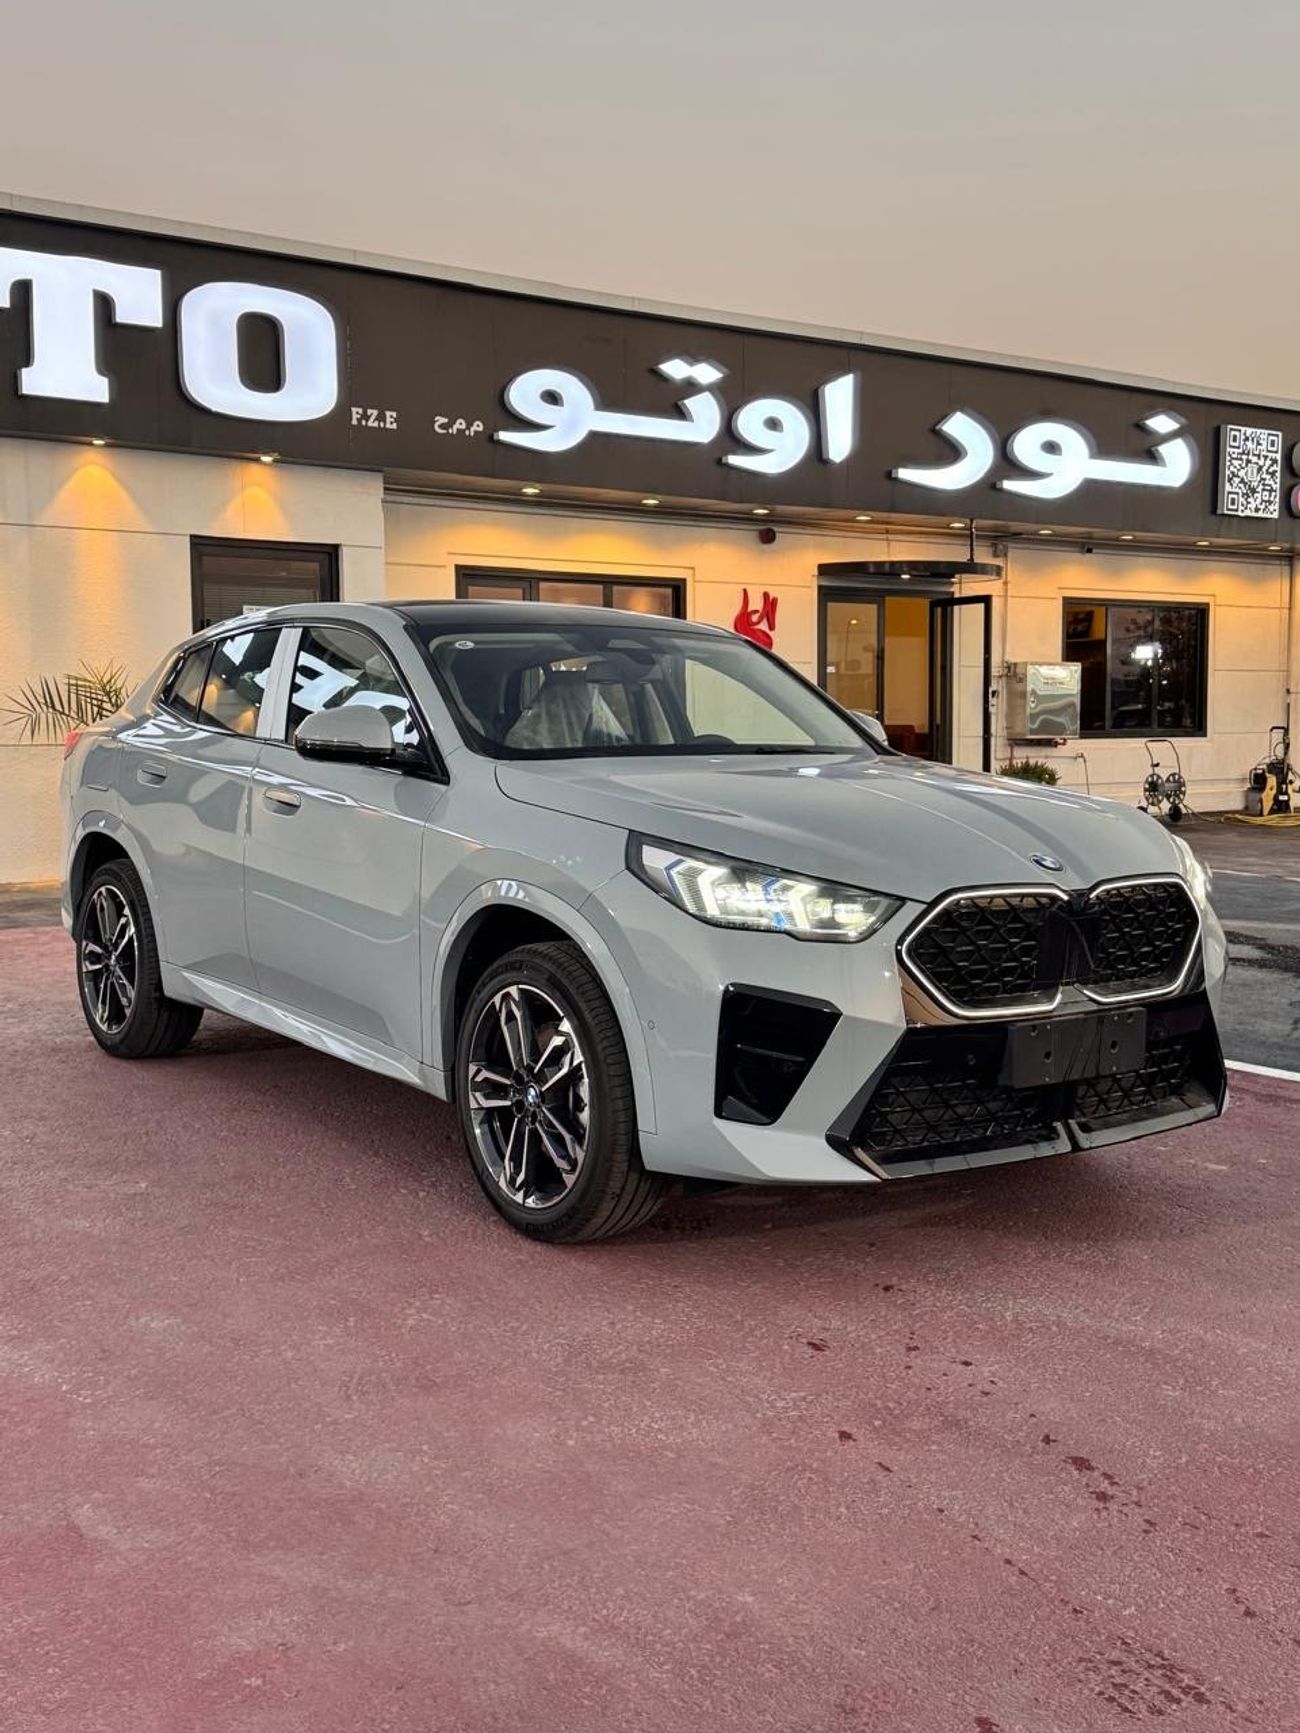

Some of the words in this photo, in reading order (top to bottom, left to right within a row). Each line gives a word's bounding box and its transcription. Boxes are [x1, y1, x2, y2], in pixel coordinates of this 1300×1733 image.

[350, 407, 398, 430] F.Z.E
[496, 358, 858, 475] اوتو
[893, 411, 1197, 500] نور
